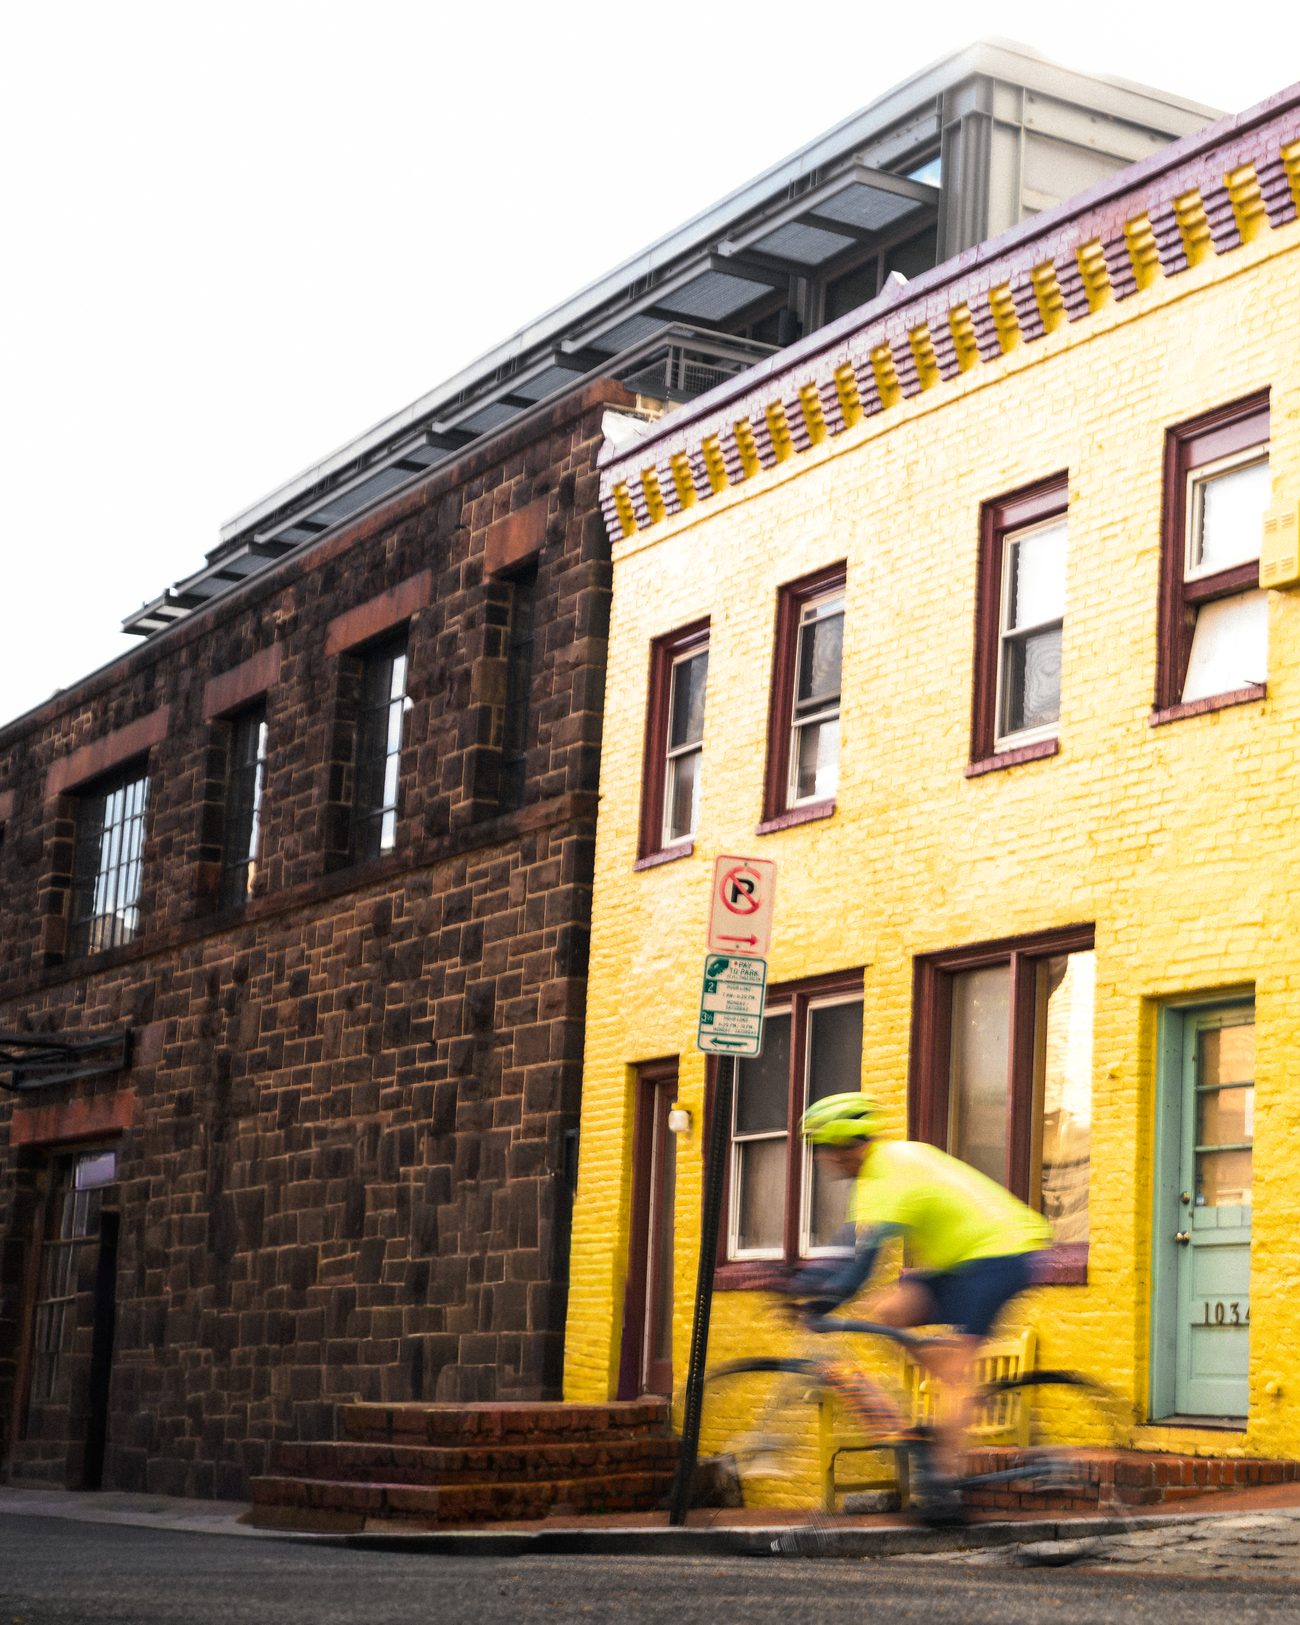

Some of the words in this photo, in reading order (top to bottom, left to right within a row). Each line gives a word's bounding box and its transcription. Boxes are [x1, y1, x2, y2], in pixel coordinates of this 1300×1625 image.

[739, 961, 752, 969] PAY
[741, 968, 758, 977] PARK
[707, 981, 714, 993] 2
